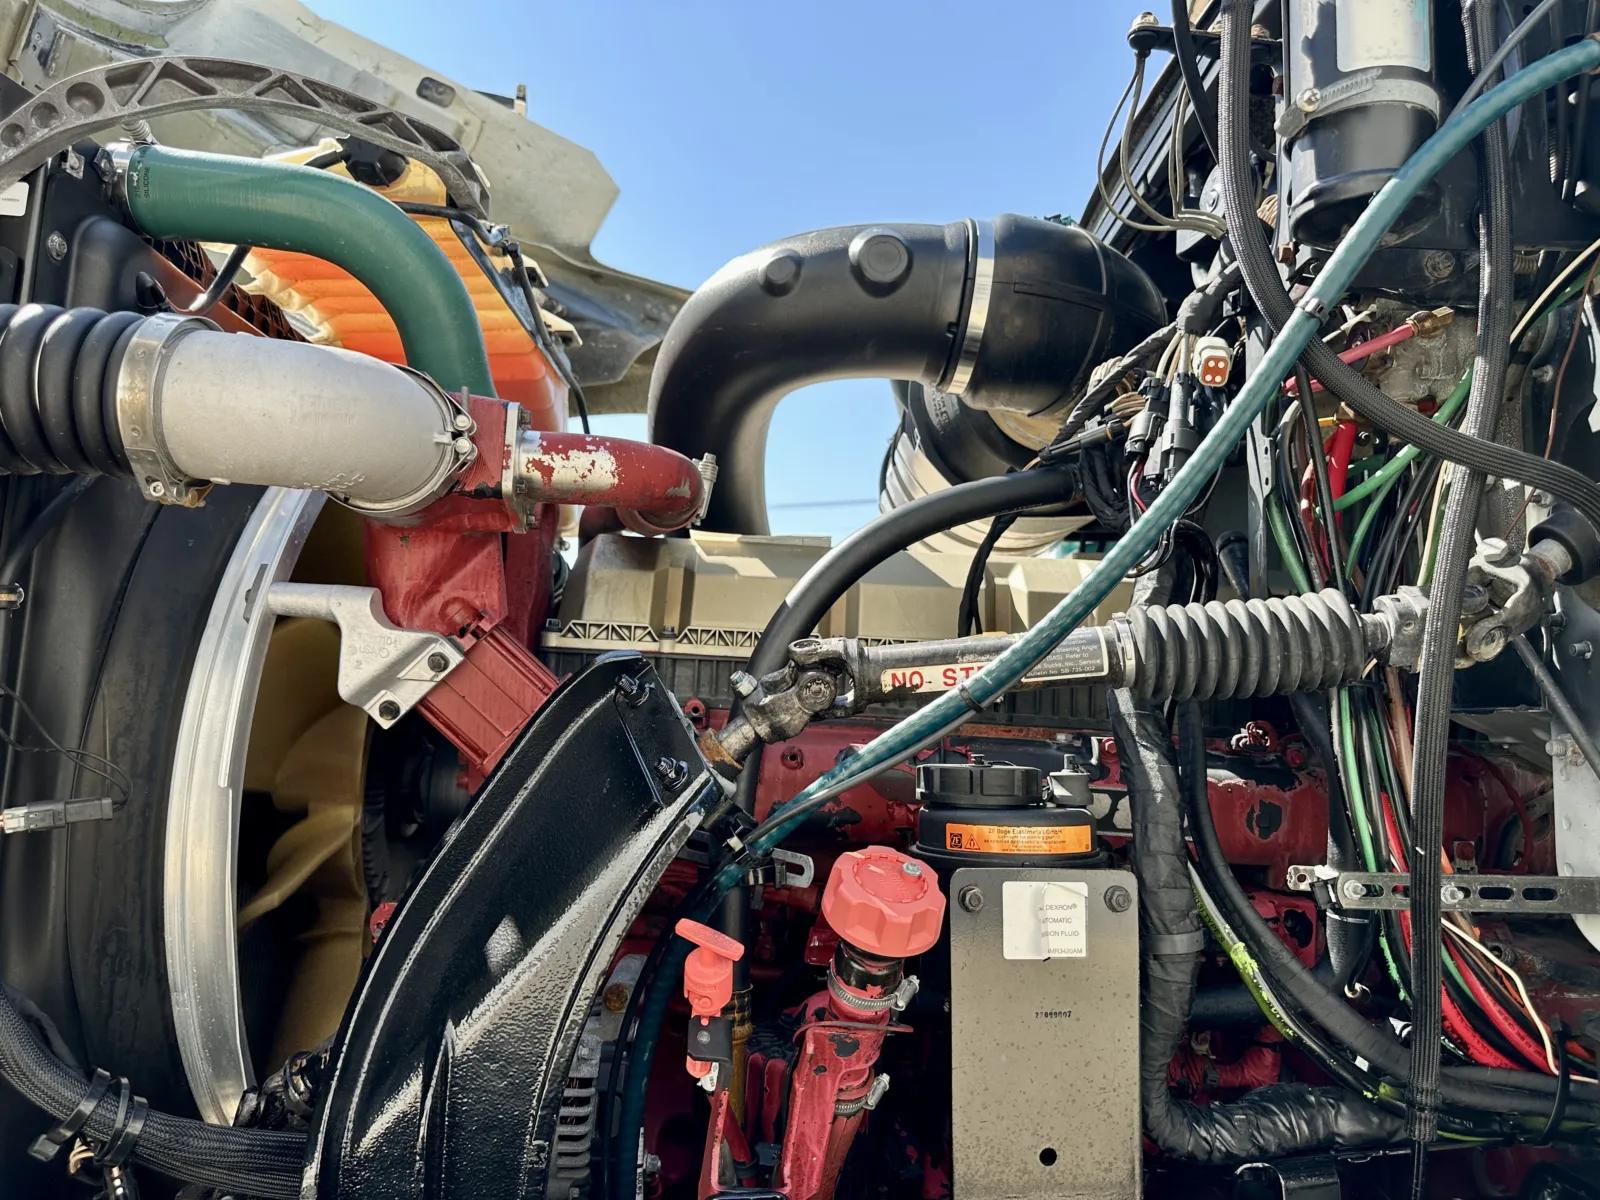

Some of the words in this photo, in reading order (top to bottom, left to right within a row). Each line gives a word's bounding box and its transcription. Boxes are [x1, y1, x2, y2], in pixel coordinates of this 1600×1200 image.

[143, 167, 151, 198] SILICONE
[891, 670, 924, 689] NO
[942, 665, 985, 687] ST
